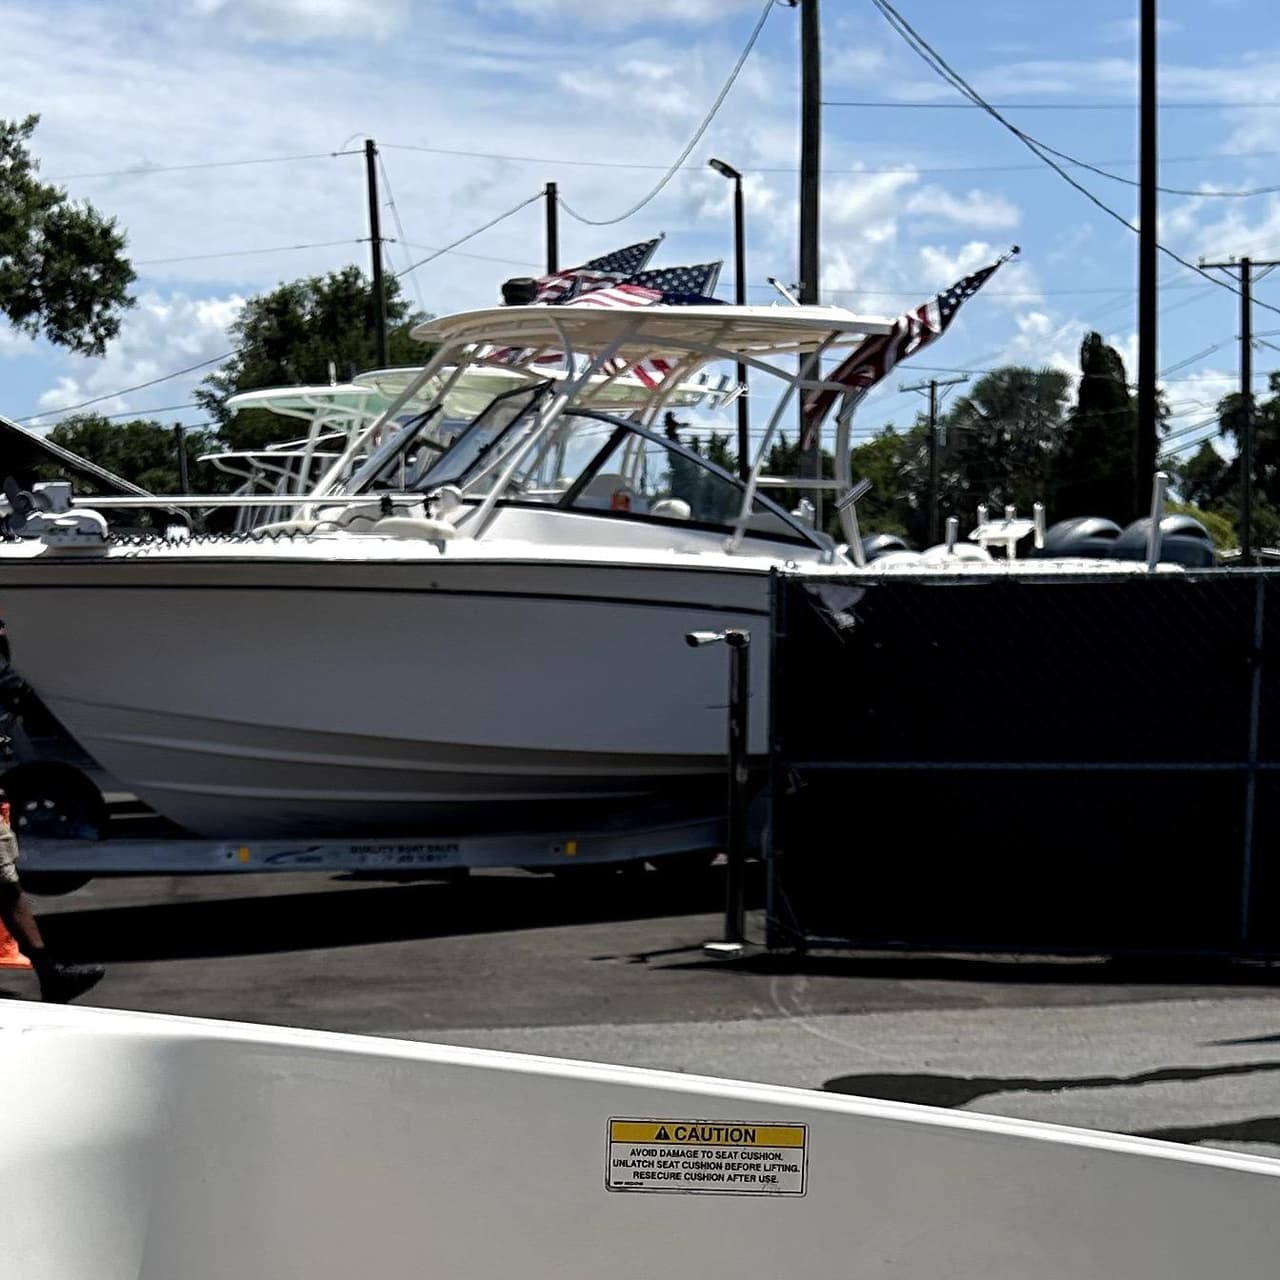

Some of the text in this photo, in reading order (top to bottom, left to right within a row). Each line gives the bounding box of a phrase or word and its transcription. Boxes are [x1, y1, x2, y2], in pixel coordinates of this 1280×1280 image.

[675, 1127, 756, 1142] CAUTION
[631, 1149, 783, 1161] AVOID DAMAGE TO SEAT CUSHION.
[613, 1159, 800, 1172] UNLATCH SEAT CUSHION BEFORE LIFTING.
[633, 1172, 779, 1183] RESECURE CUSHION AFTER USE.
